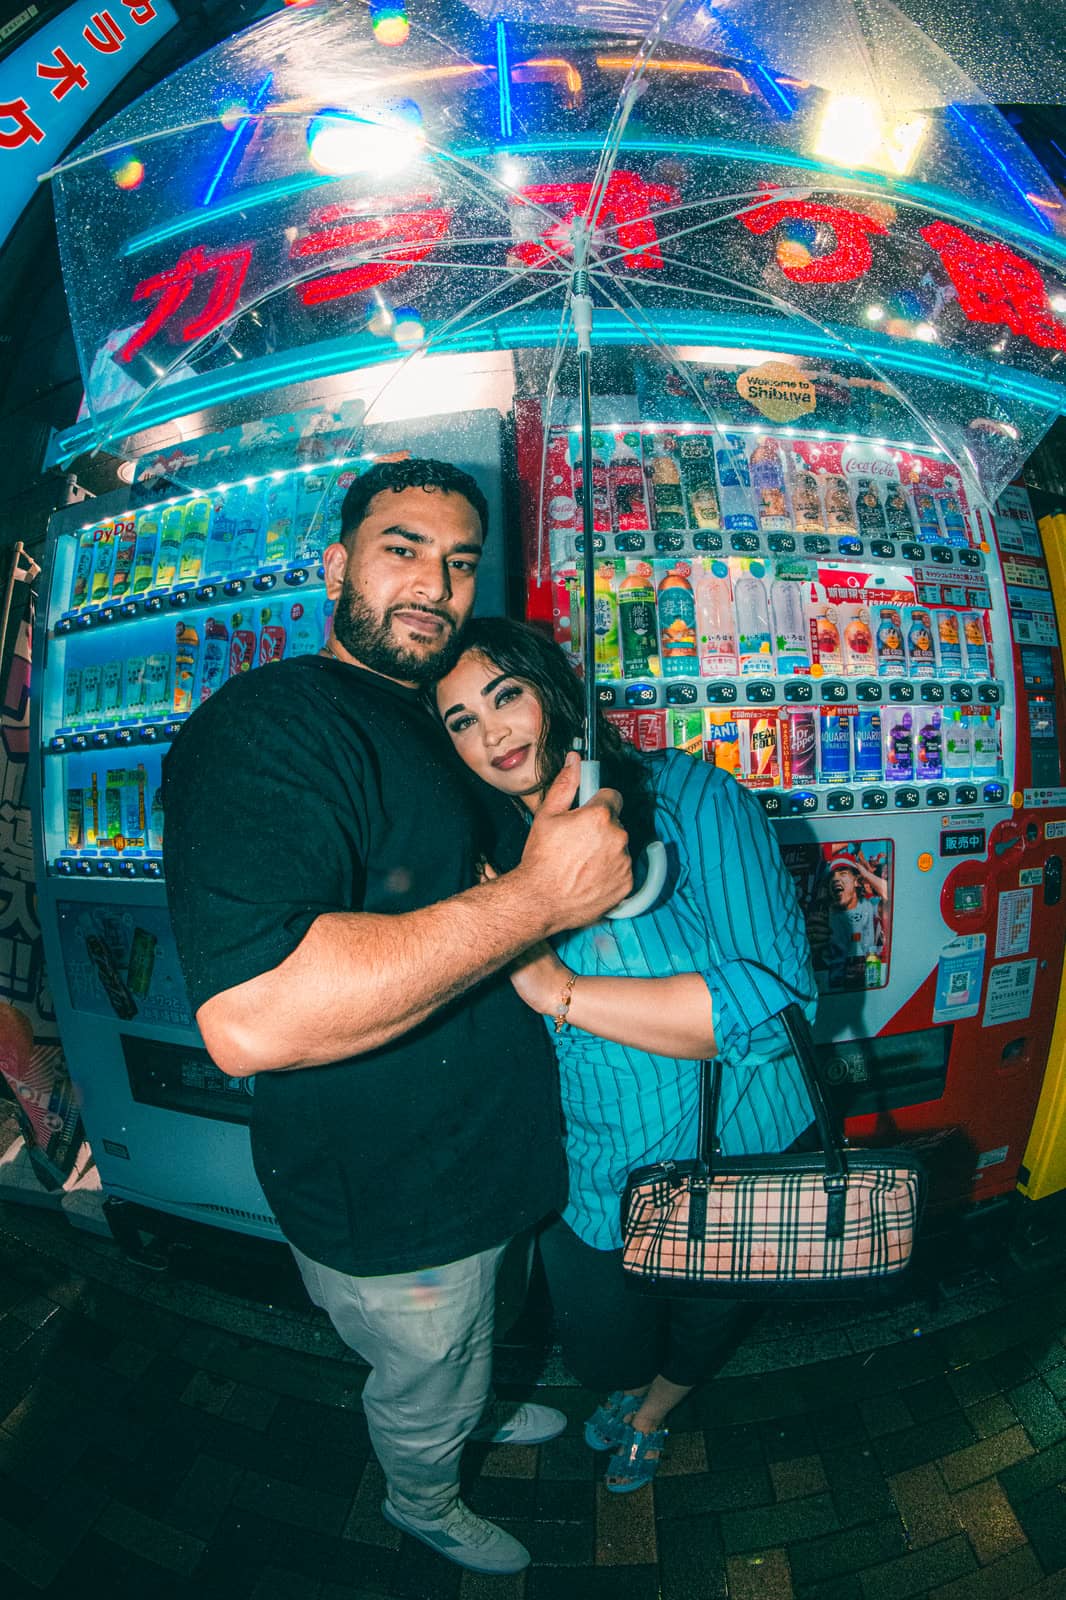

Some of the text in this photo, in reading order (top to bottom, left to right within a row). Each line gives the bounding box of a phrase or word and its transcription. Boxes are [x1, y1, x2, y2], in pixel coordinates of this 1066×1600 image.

[747, 376, 809, 389] Welcome to
[748, 386, 811, 404] Shibuya
[846, 457, 895, 478] Coca-Cola
[93, 522, 135, 542] DyDo
[664, 600, 689, 616] 麦茶
[753, 728, 775, 741] REAL
[797, 729, 808, 740] Dr
[945, 835, 980, 850] 販売中
